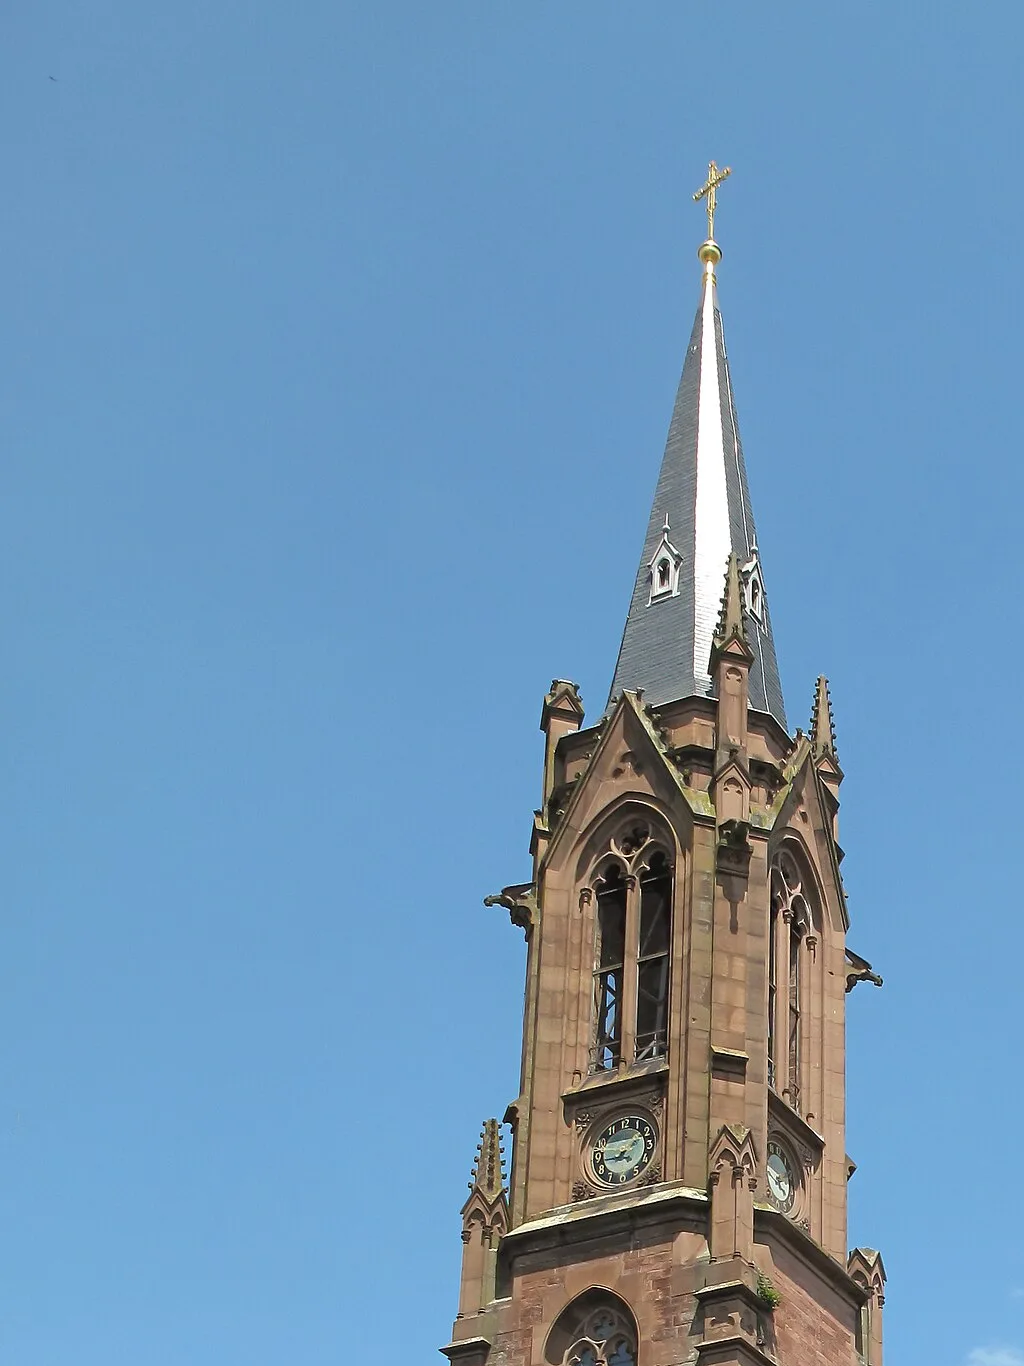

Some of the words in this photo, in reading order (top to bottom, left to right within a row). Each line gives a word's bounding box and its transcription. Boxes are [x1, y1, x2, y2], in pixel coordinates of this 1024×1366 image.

[621, 1119, 630, 1129] 12
[636, 1120, 640, 1129] 1
[608, 1125, 615, 1135] 11
[644, 1126, 650, 1136] 2
[646, 1140, 653, 1149] 3
[595, 1152, 601, 1163] 9
[642, 1153, 648, 1163] 4
[598, 1164, 605, 1175] 8
[633, 1166, 639, 1175] 5
[607, 1172, 613, 1182] 7
[620, 1172, 626, 1182] 6
